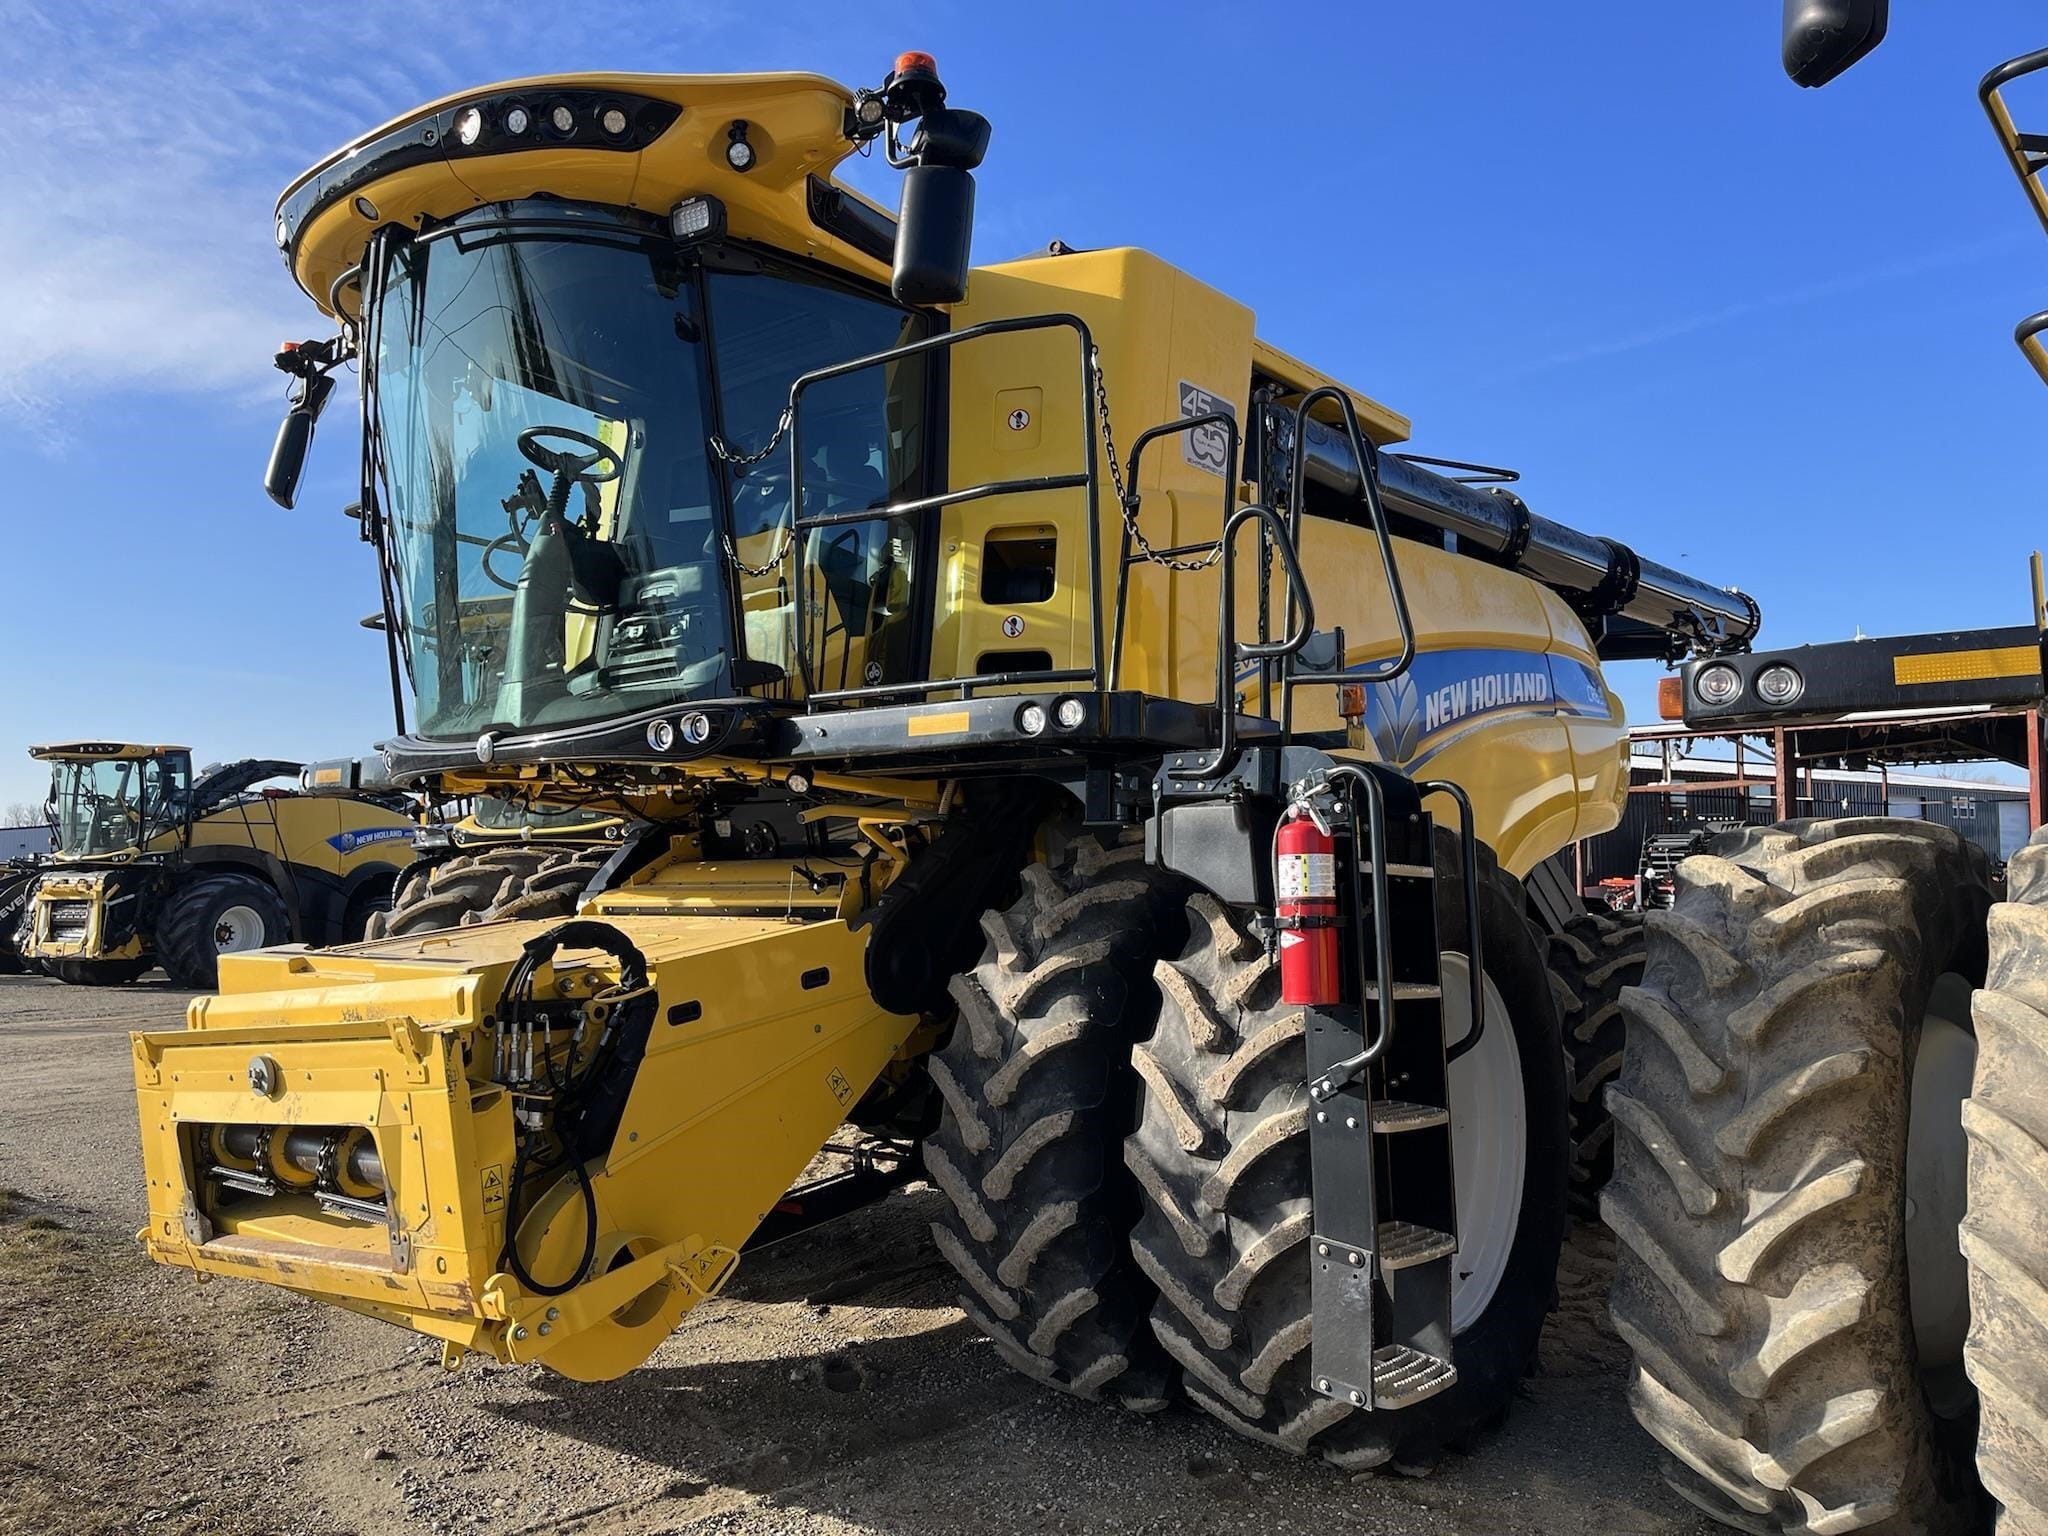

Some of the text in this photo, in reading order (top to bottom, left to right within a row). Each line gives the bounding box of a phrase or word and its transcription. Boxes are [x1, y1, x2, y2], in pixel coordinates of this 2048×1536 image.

[1425, 672, 1547, 732] NEW HOLLAND
[356, 833, 374, 845] NEW
[374, 830, 403, 841] HOLLAND
